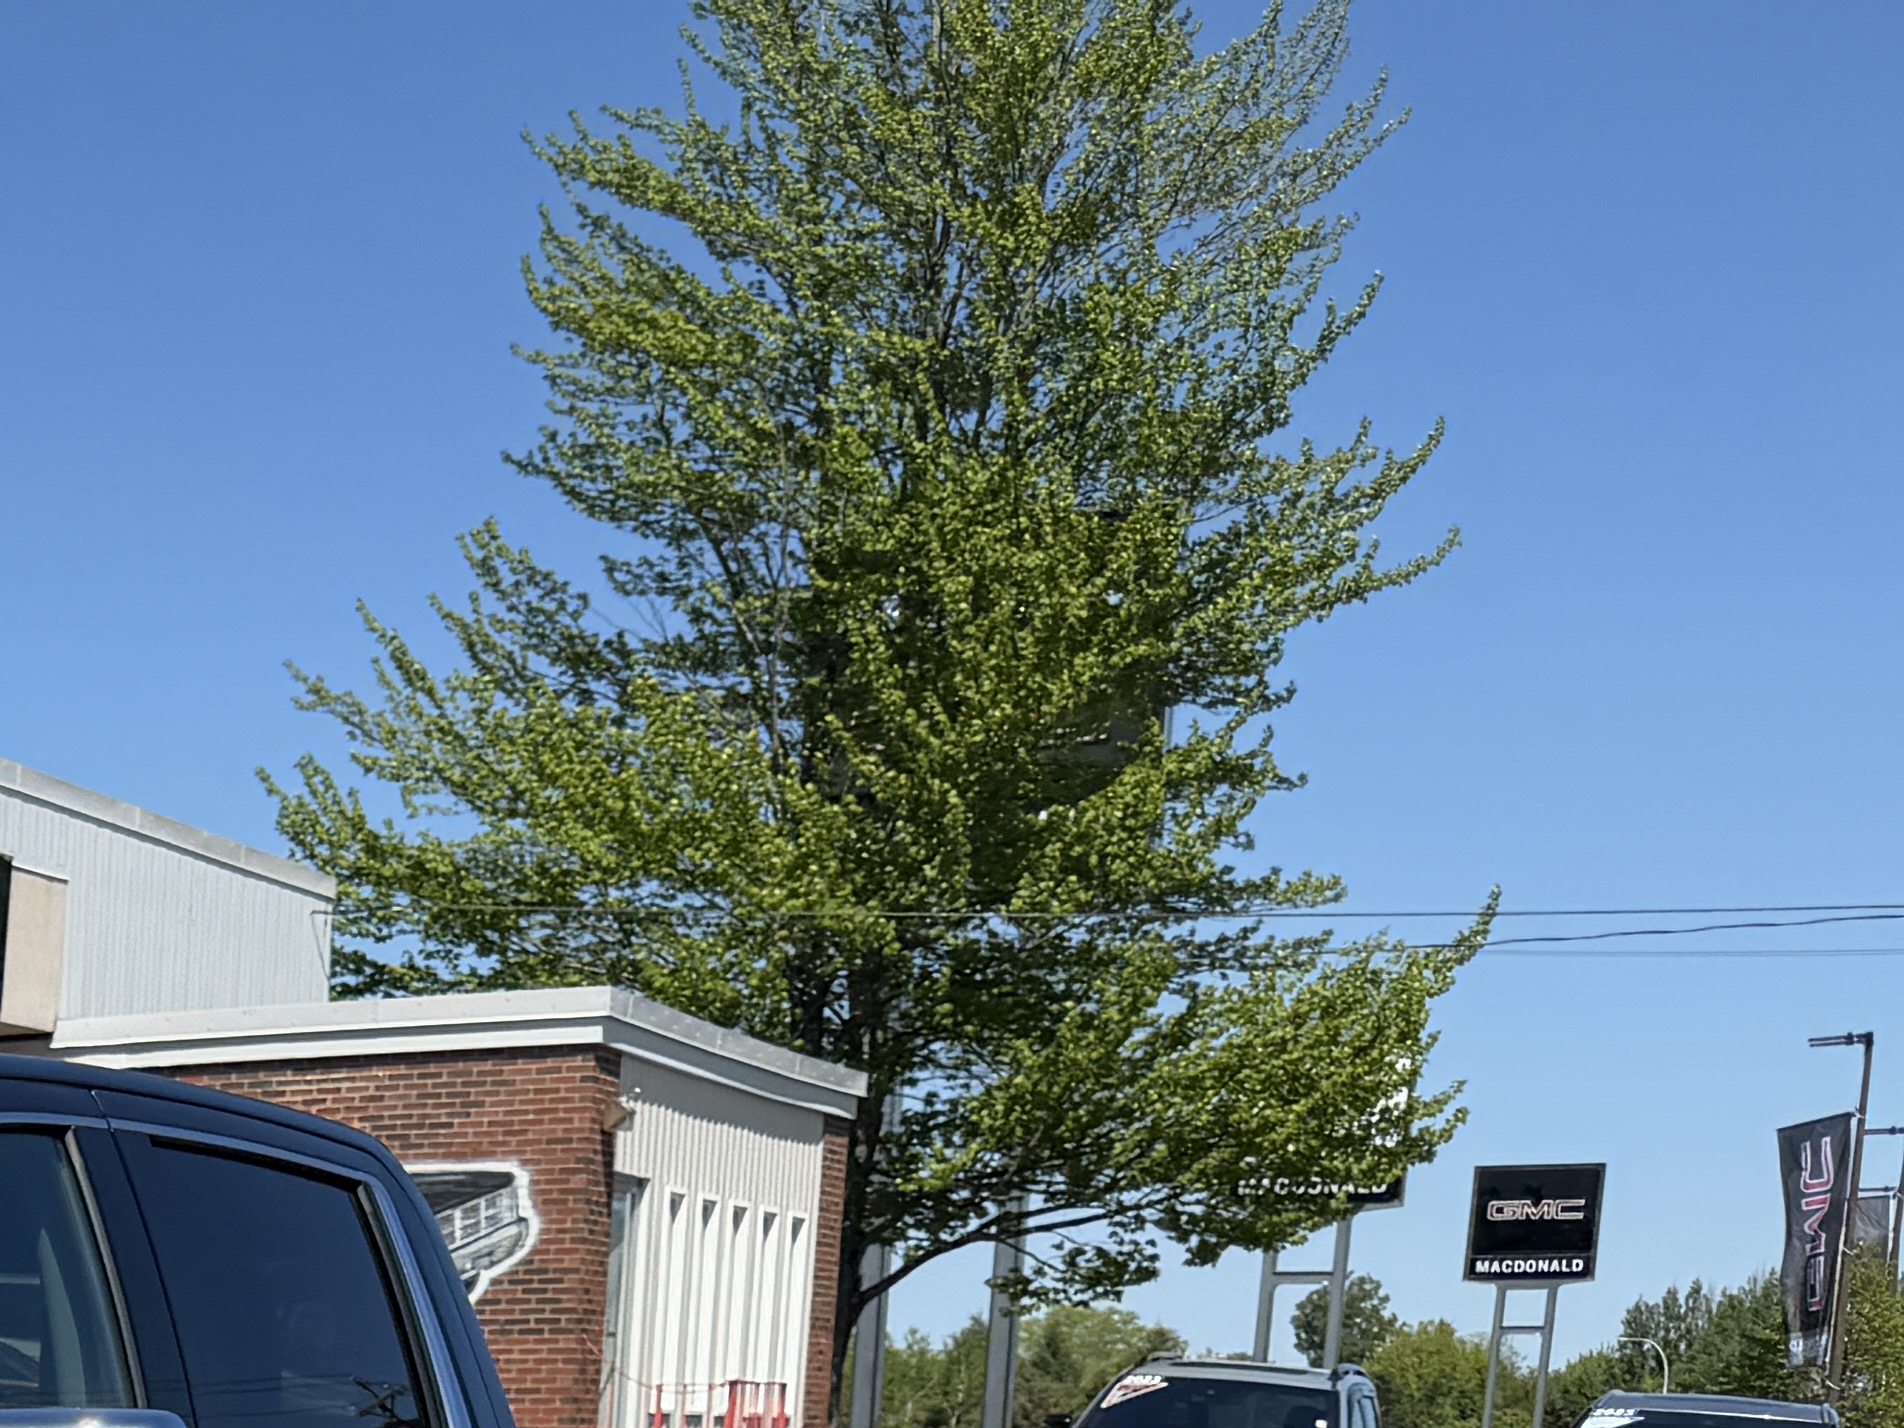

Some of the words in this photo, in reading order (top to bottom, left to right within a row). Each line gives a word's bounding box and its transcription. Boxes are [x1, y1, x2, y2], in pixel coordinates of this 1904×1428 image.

[1486, 1199, 1586, 1221] GMC
[1800, 1136, 1834, 1312] GMC
[1475, 1259, 1584, 1273] MACDONALD
